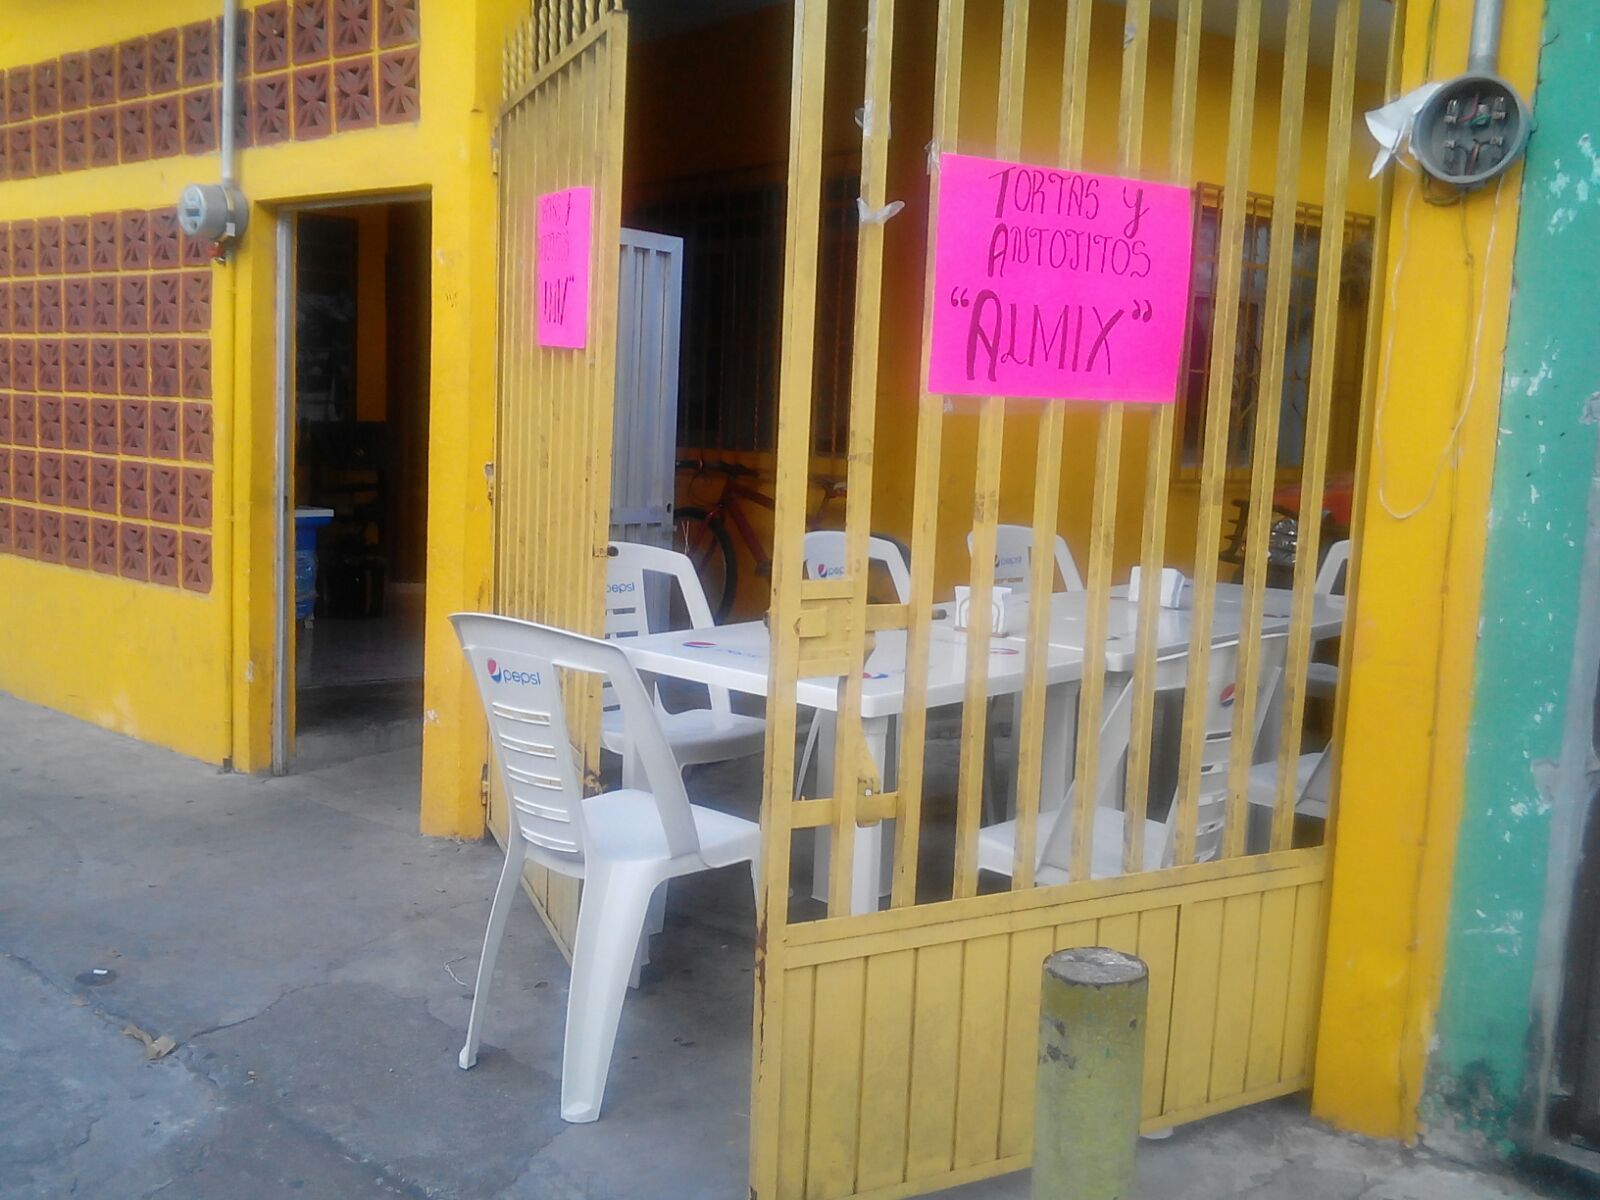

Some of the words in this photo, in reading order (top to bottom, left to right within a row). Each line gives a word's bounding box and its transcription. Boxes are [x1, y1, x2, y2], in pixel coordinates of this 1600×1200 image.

[989, 166, 1100, 220] TORTAS
[987, 223, 1152, 278] ANTOJITOS
[502, 668, 541, 686] pepsi
